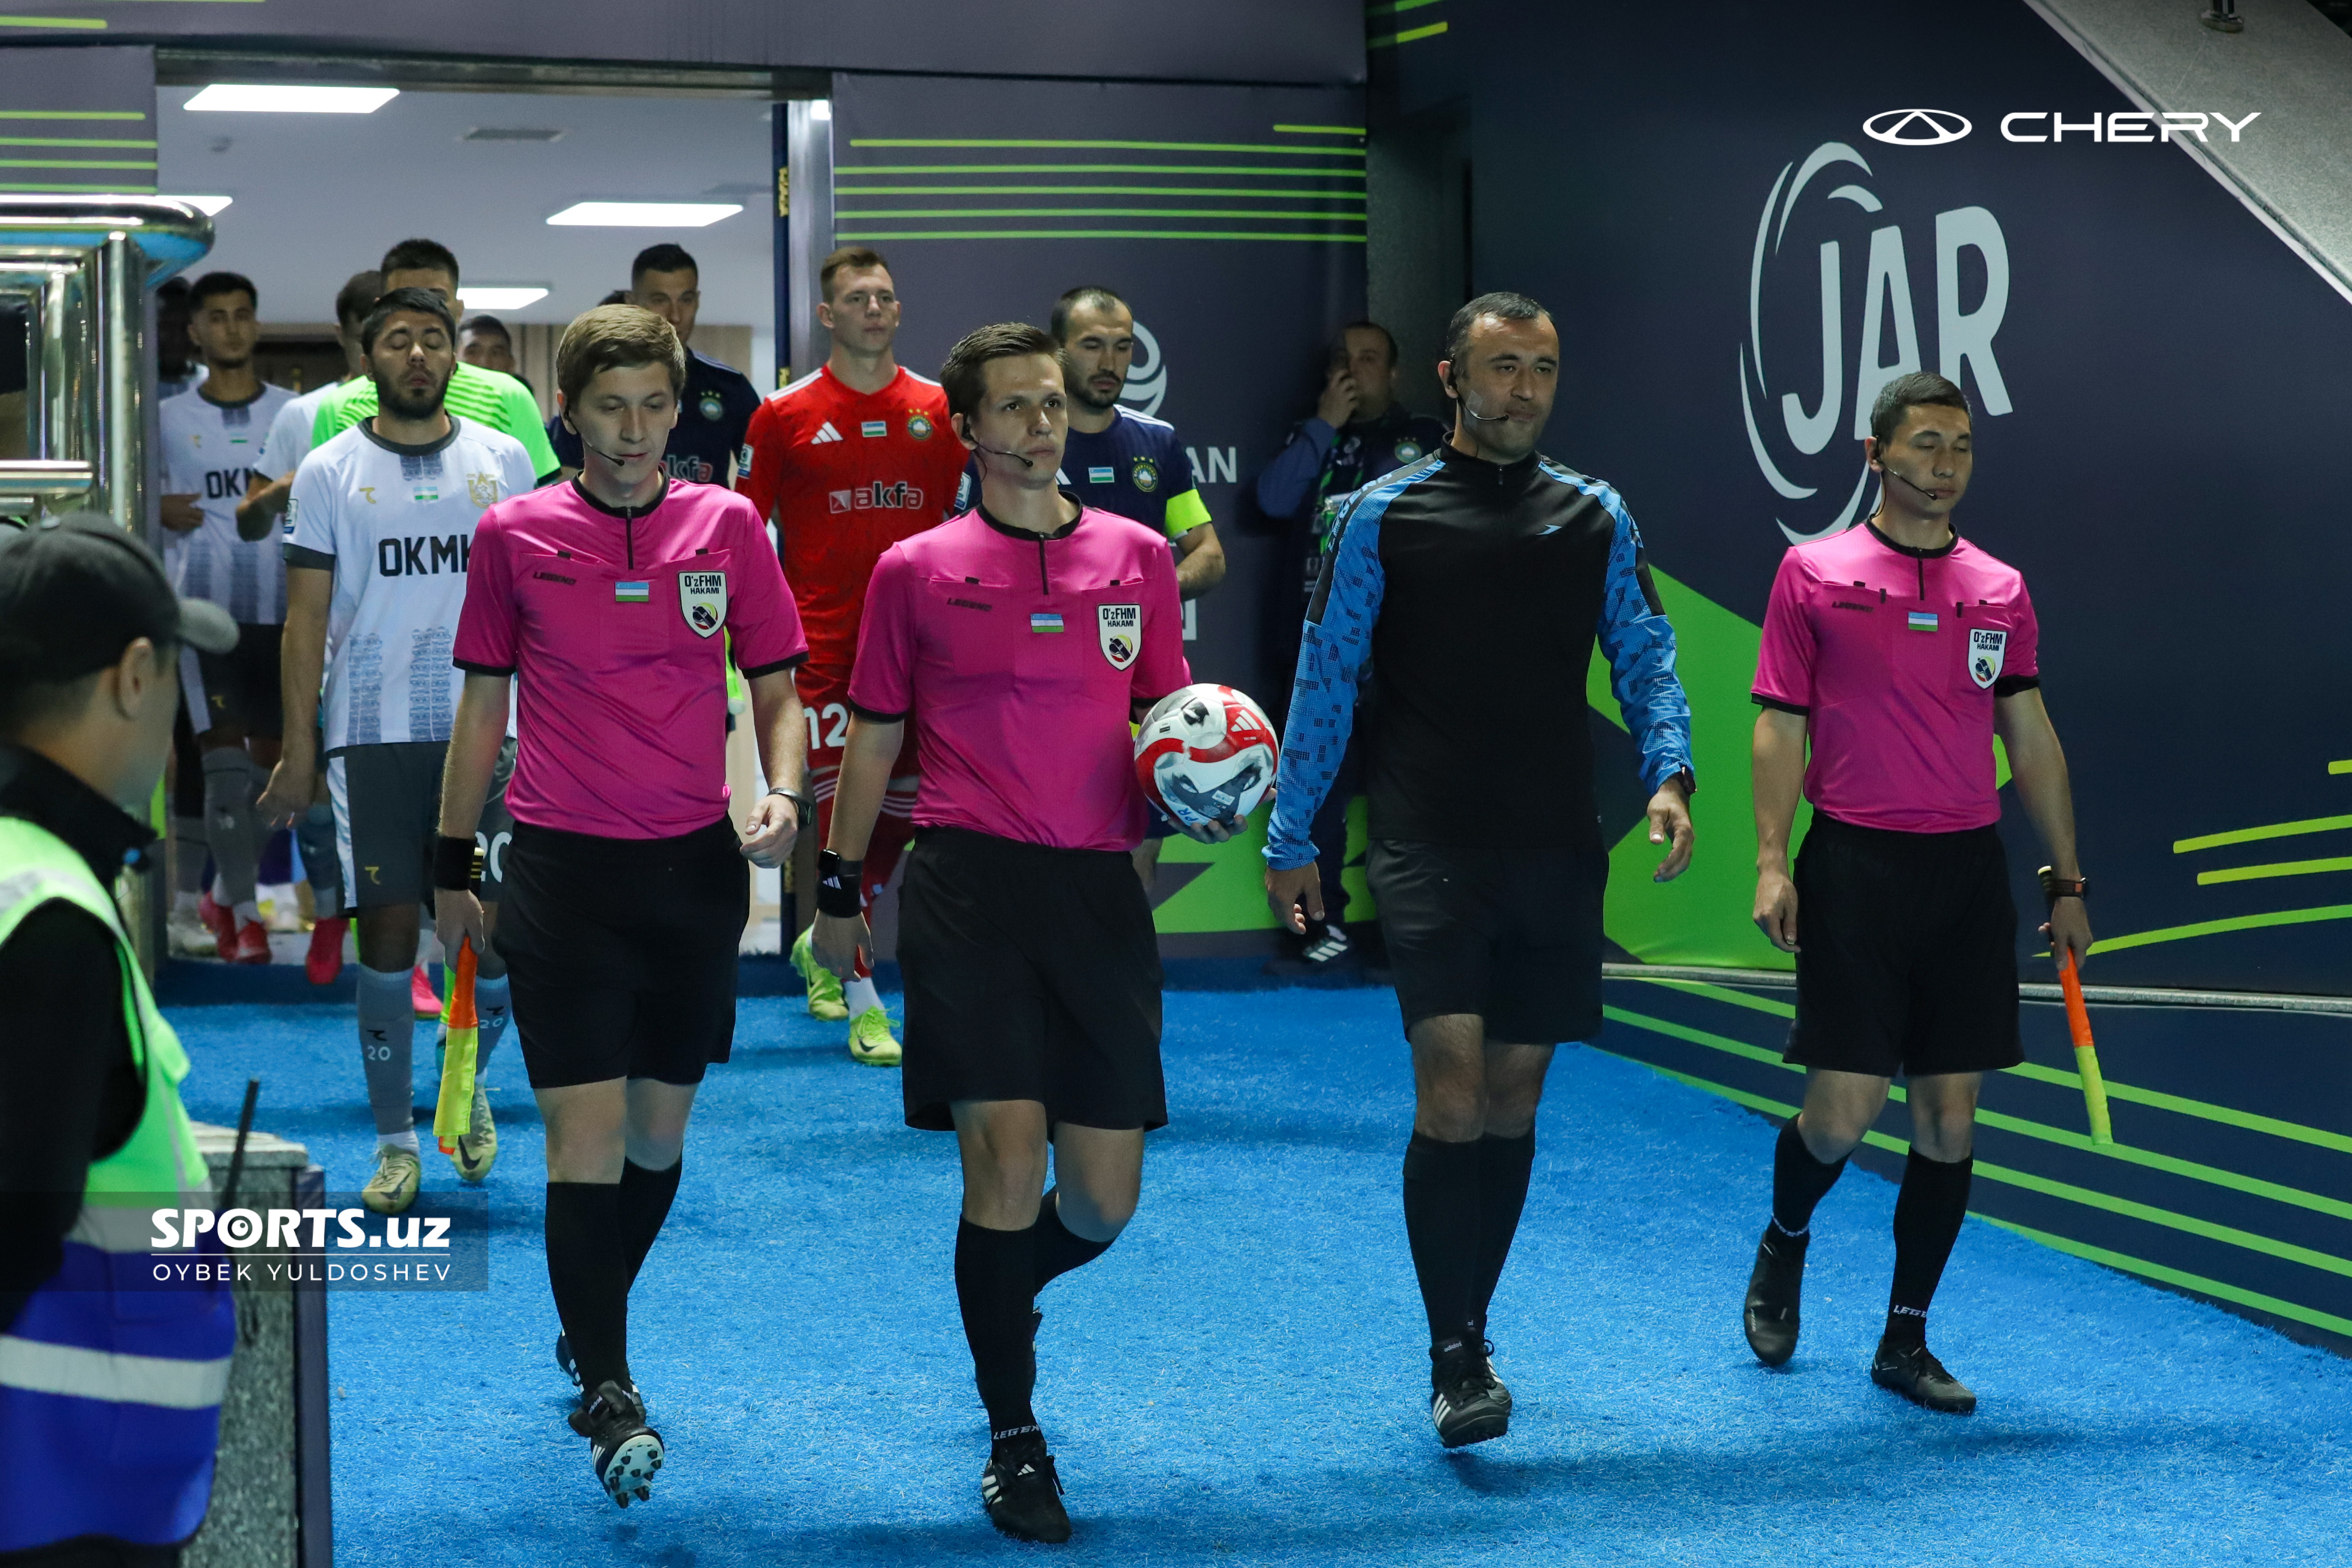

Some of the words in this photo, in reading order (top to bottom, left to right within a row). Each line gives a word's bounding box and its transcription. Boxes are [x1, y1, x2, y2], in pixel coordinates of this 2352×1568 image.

[1782, 205, 2014, 455] JAR
[854, 481, 924, 510] akfa
[1977, 643, 2000, 652] HAKAMI
[803, 702, 848, 750] 12
[479, 1017, 504, 1030] 20
[367, 1045, 391, 1061] 20
